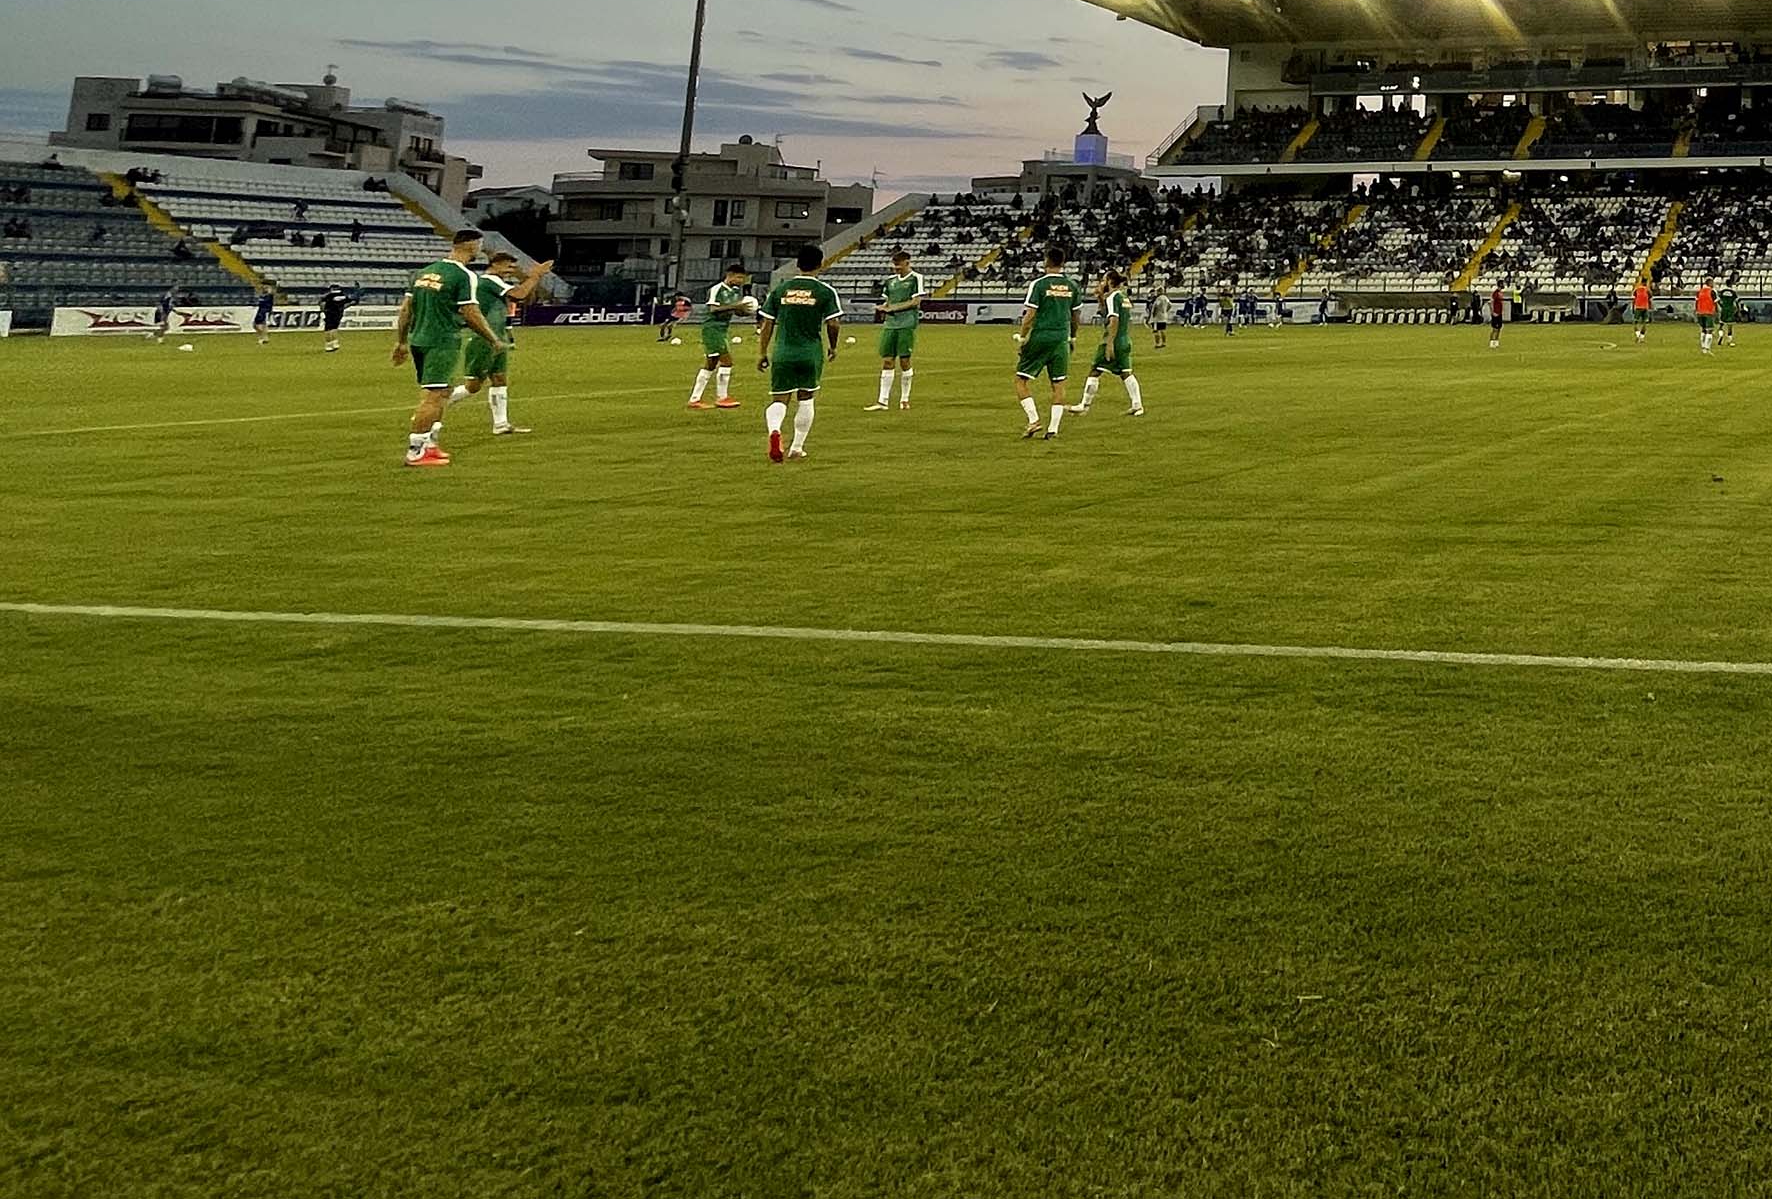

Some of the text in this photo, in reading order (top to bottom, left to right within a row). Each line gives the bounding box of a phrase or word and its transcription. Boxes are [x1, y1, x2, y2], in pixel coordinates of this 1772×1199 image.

[99, 311, 149, 323] ACS
[189, 311, 234, 323] ACS
[569, 307, 644, 323] cablenet
